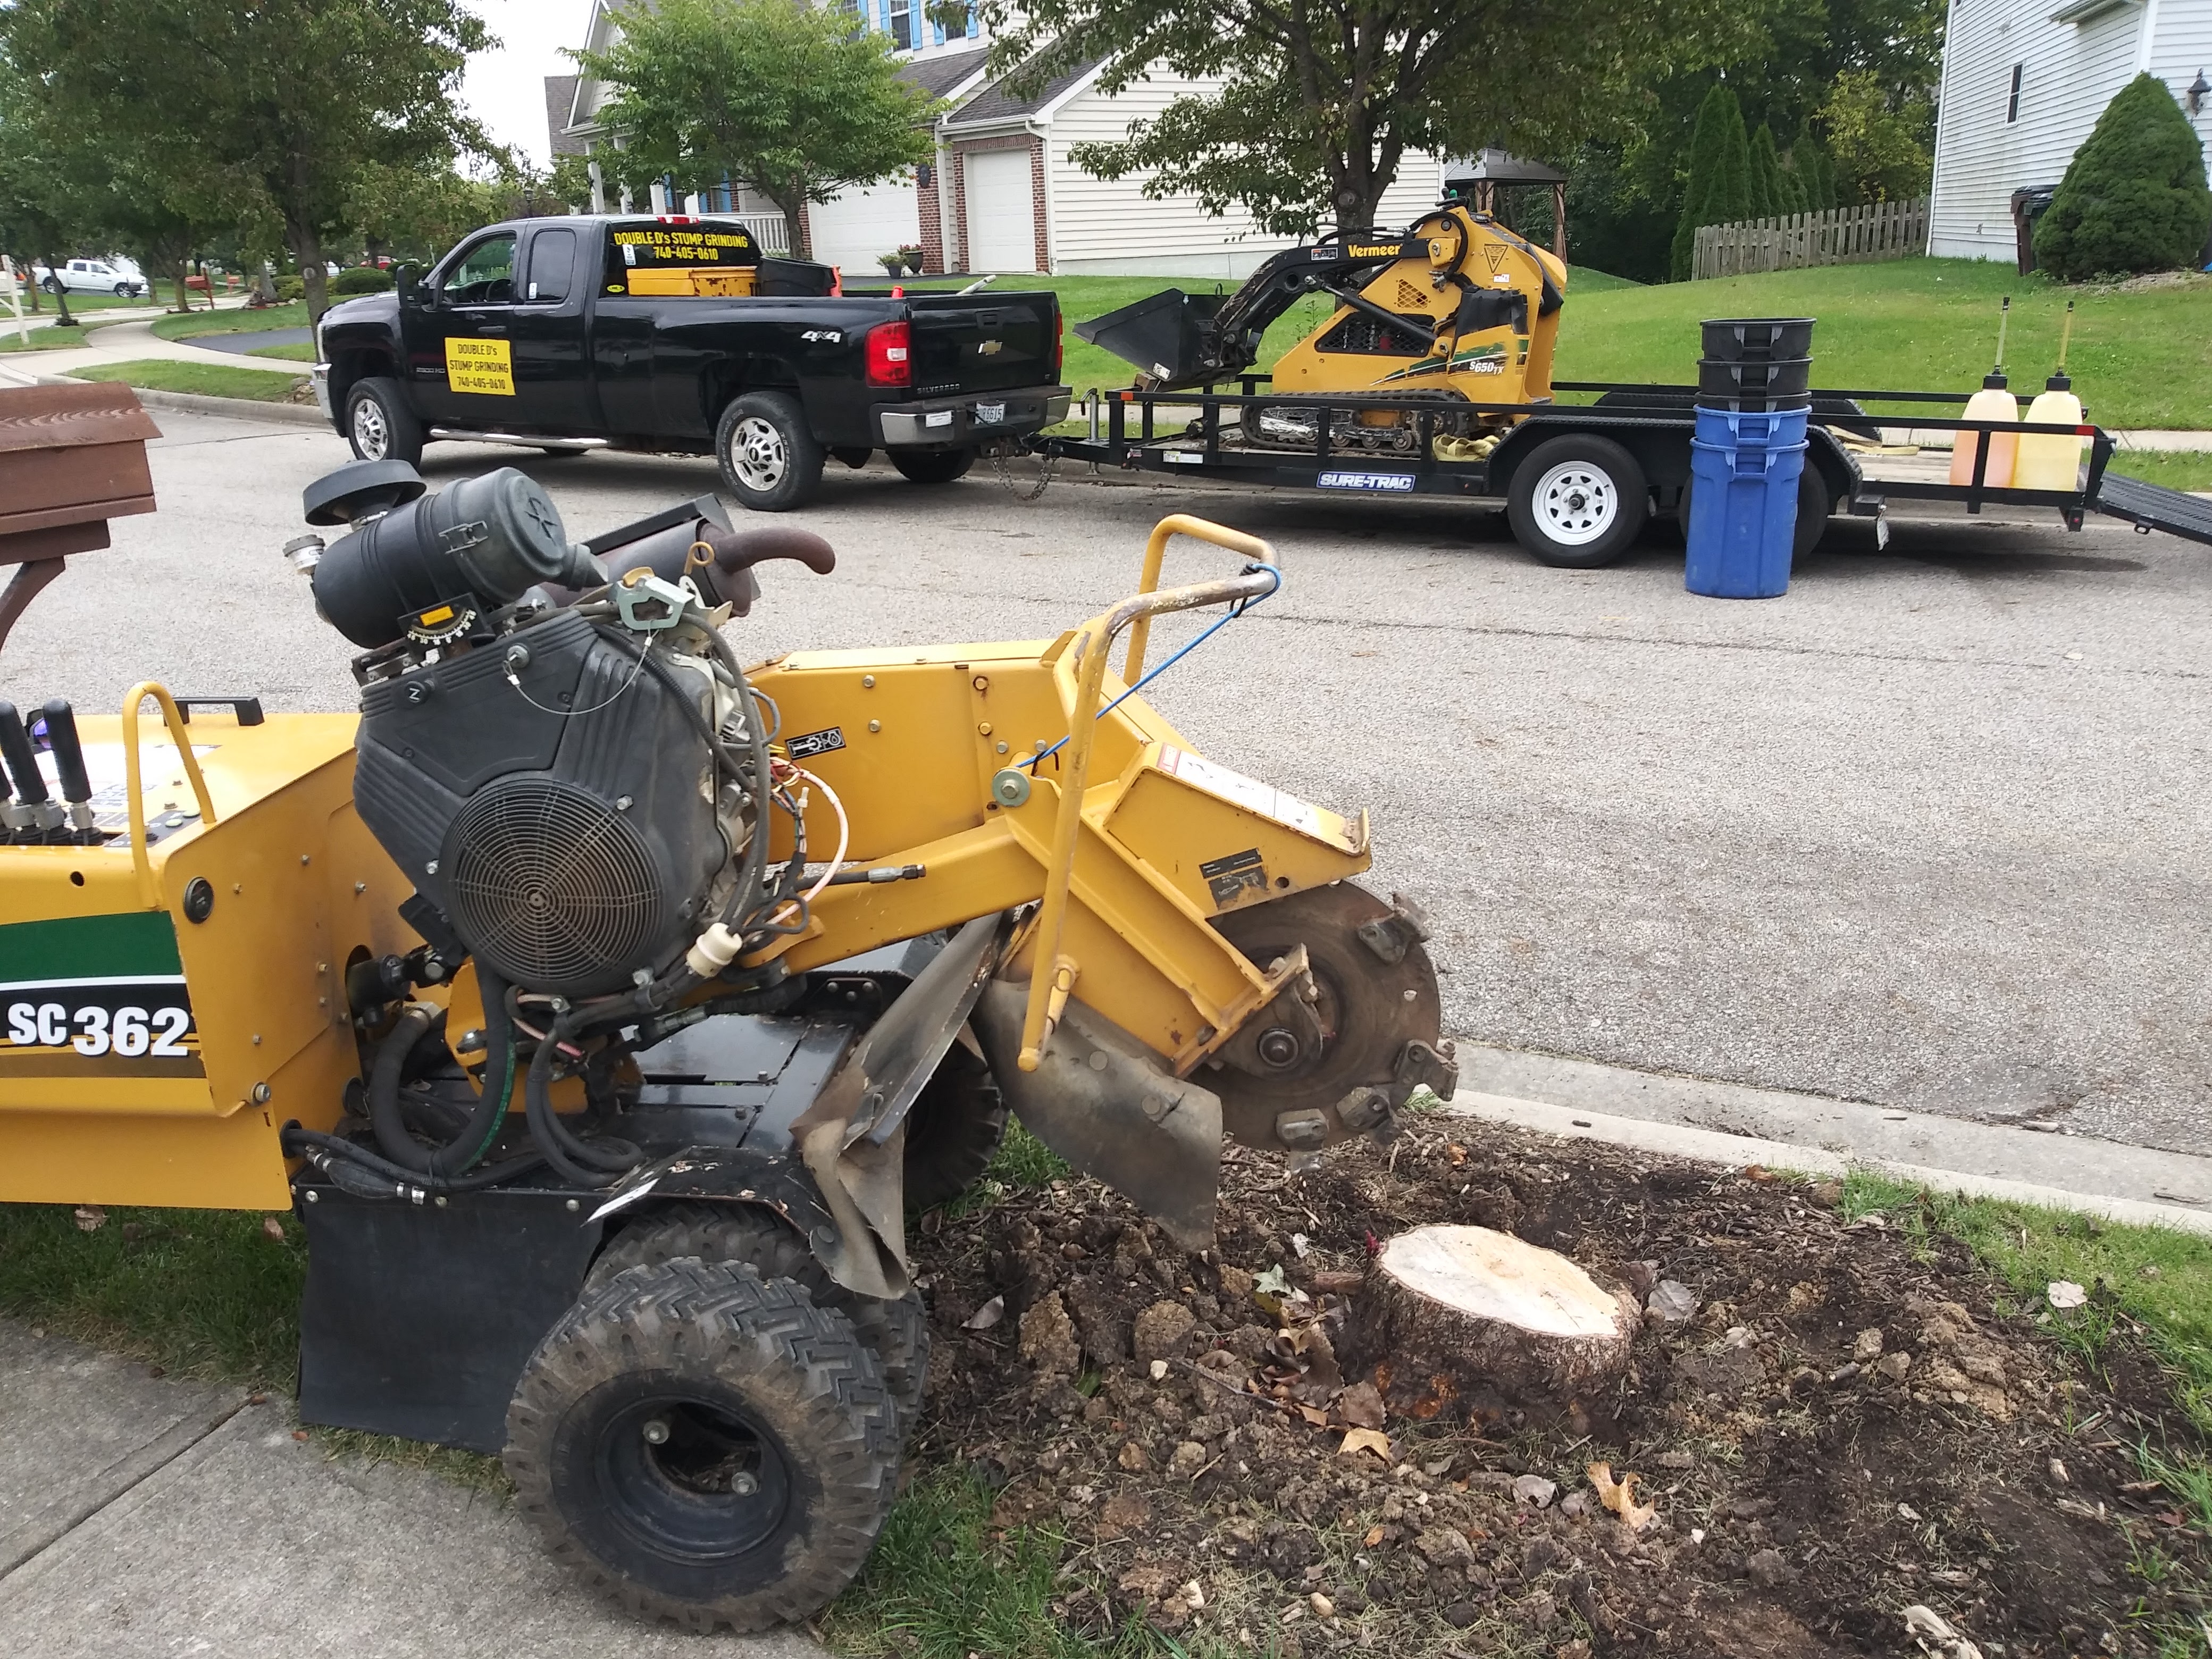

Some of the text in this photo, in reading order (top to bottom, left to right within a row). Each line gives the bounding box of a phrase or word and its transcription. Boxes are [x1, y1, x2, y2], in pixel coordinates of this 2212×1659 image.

[614, 232, 749, 248] DOUBLE D's STUMP GRINDING
[653, 246, 719, 260] 740-405-0610
[1347, 244, 1401, 257] Vermeer
[457, 343, 498, 356] DOUBLE D's
[449, 359, 509, 373] STUMP GRINDING
[457, 376, 506, 390] 740-405-0610
[917, 383, 960, 394] SILVERADO
[1319, 473, 1412, 490] SURE-TRAC
[7, 1002, 190, 1057] SC362
